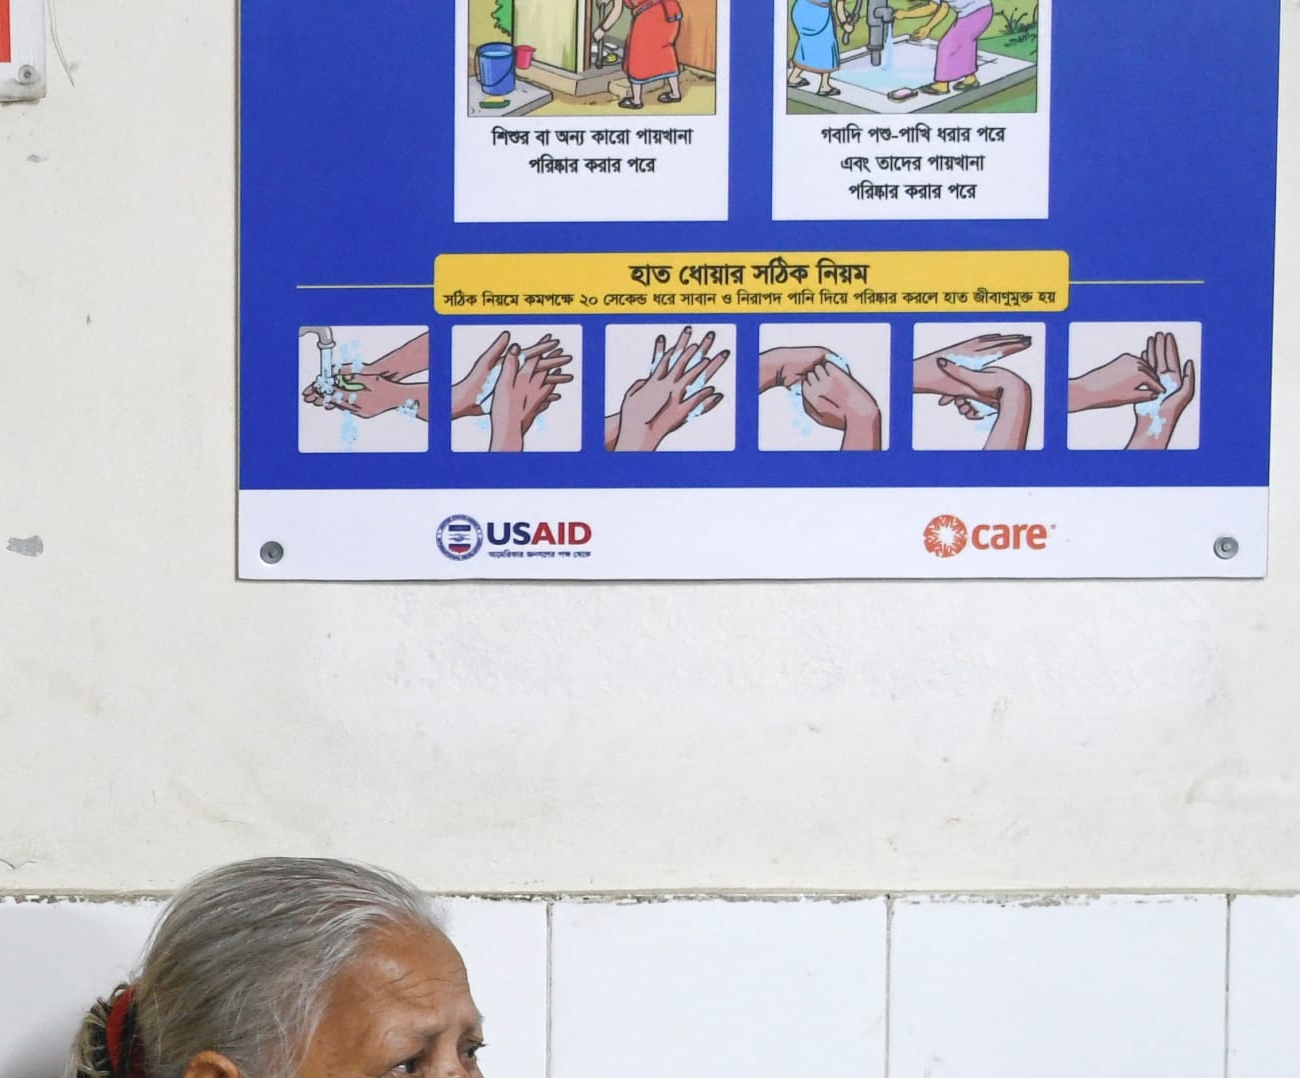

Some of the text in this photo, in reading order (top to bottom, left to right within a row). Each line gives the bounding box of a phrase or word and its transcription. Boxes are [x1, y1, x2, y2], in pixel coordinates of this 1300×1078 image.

[491, 126, 693, 146] শিশুর বা অন্য কারো পায়খানা
[821, 122, 1006, 143] গবাদি পশু-পাখি ধরার পরে
[529, 154, 656, 173] পরিষ্কার করার পরে
[841, 154, 985, 172] এবং তাদের পায়খানা
[849, 180, 977, 200] পরিষ্কার করার পরে
[629, 256, 870, 287] হাত ধোয়ার সঠিক নিয়ম
[444, 287, 1056, 307] সঠিক নিয়মে কমপক্ষে ২০ সেকেন্ড ধরে সাবান ও নিরাপদ পানি দিয়ে পরিষ্কার করলে হাত জীবাণুমুক্ত হয়
[487, 522, 591, 545] USAID
[972, 524, 1047, 550] care
